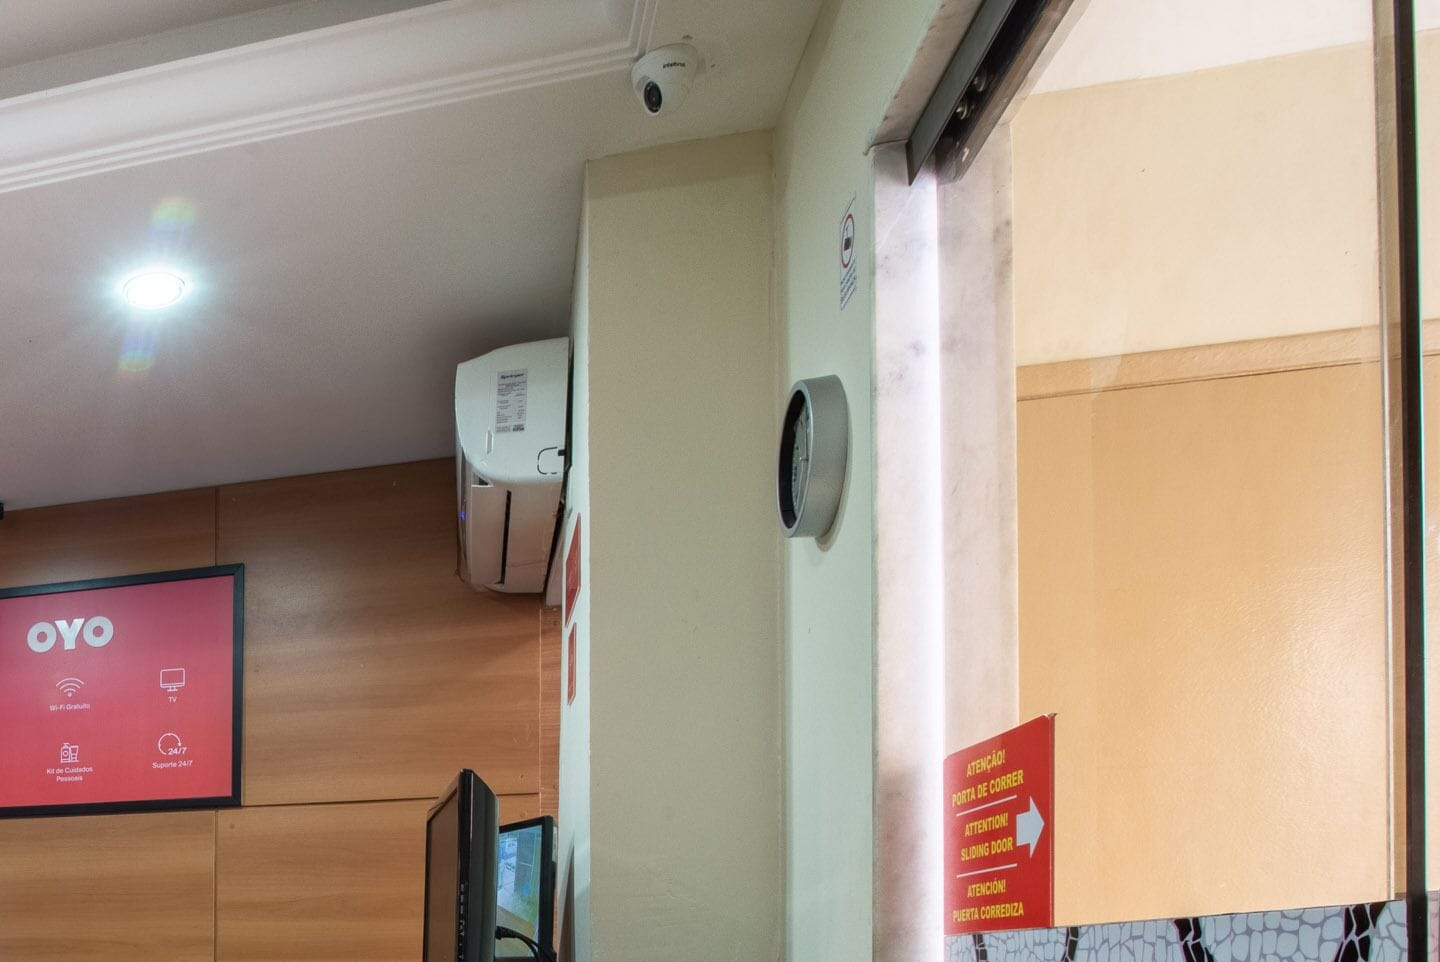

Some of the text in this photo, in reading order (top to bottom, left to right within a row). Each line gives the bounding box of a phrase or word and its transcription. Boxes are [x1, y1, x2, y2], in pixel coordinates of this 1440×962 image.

[27, 616, 114, 653] OYO
[49, 703, 91, 712] Wi-Fi Gratuito
[168, 747, 187, 755] 24/7
[65, 766, 93, 774] Cuidados
[152, 761, 177, 769] Suporte
[966, 749, 1006, 777] ATENÇÃO!
[952, 769, 1024, 808] PORTA DE CORRER
[964, 812, 1009, 837] ATTENTION!
[961, 837, 1013, 862] SLIDING DOOR
[967, 877, 1006, 898] ATENCIÓN!
[953, 901, 1024, 922] PUERTA CORREDIZA
